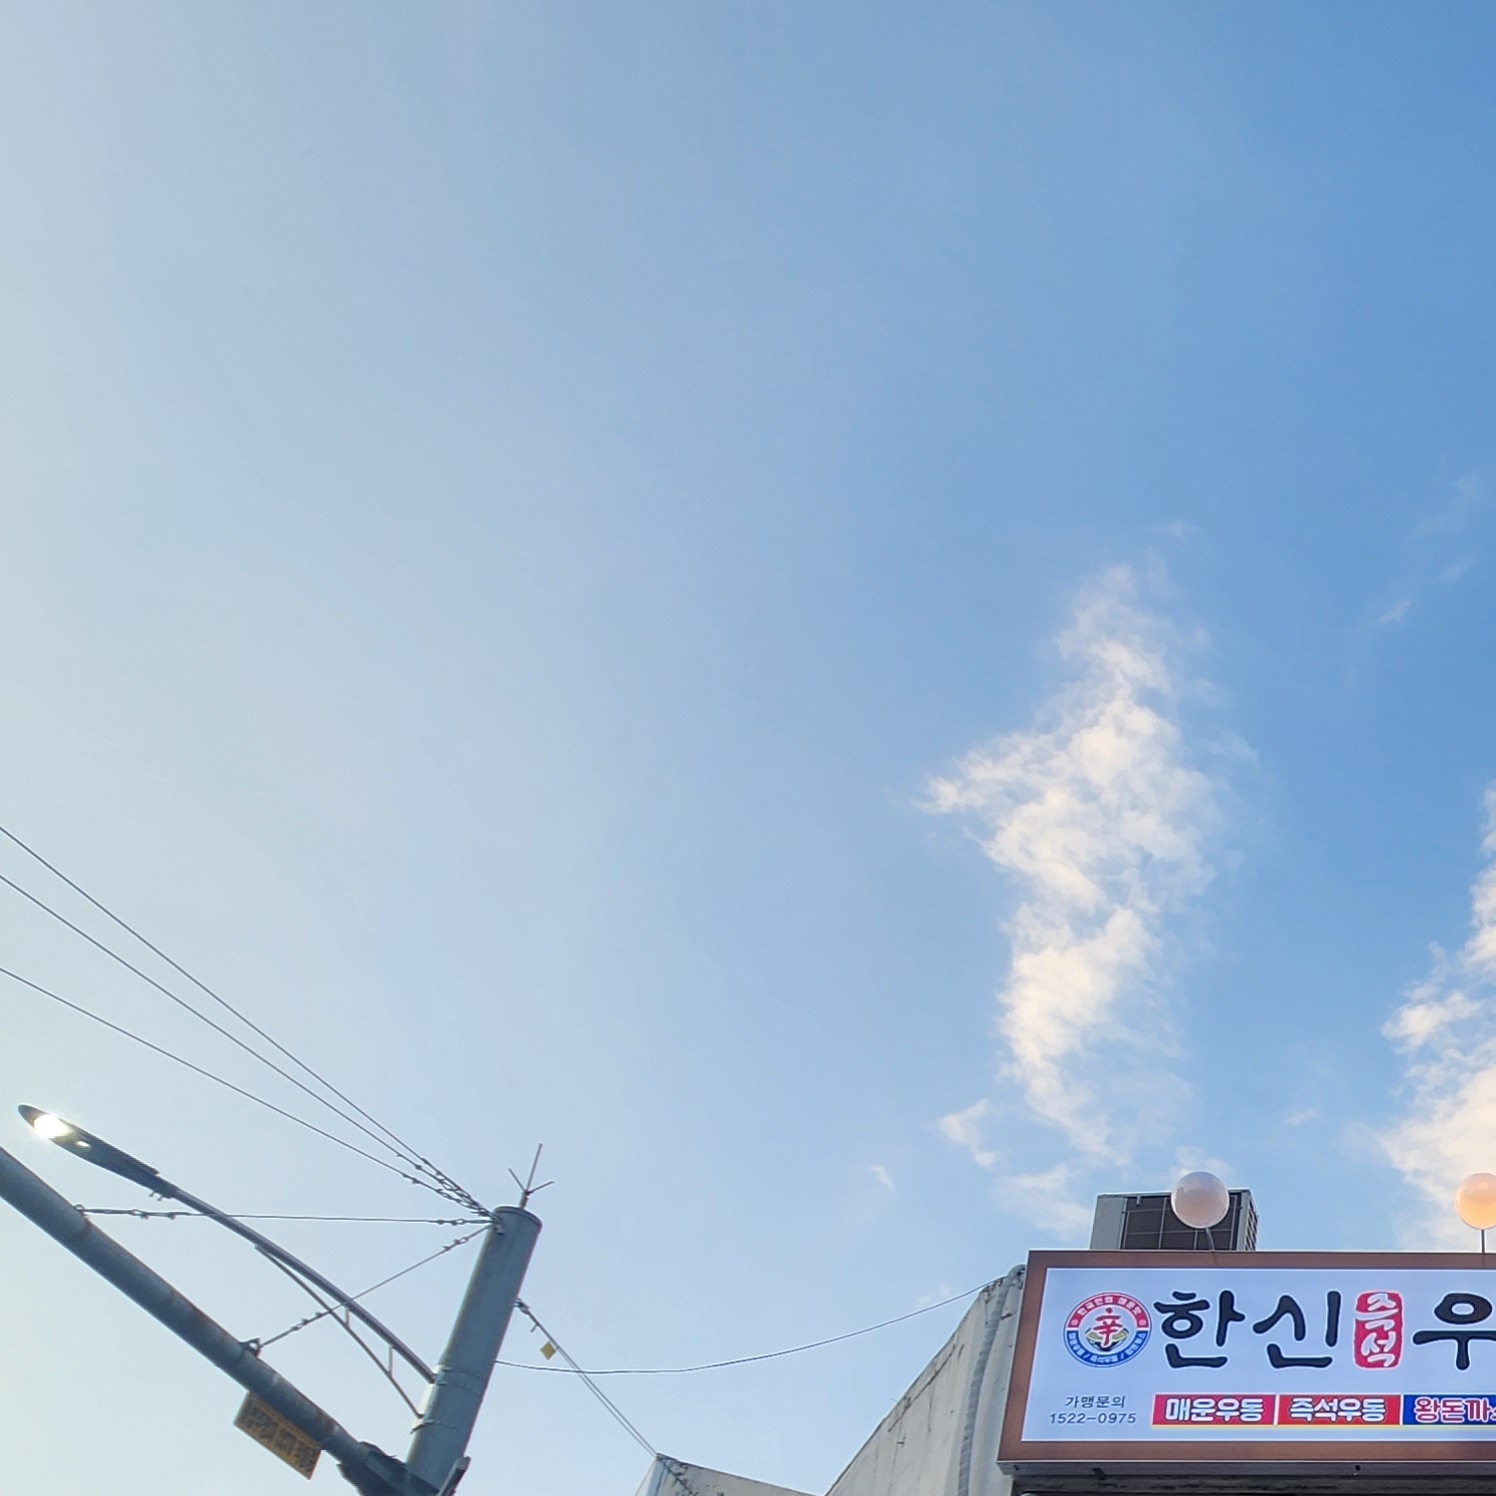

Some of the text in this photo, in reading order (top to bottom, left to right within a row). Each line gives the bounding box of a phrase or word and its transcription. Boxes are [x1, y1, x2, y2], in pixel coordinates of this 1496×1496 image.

[1154, 1289, 1341, 1369] 한신
[1356, 1291, 1402, 1368] 즉석
[1065, 1395, 1125, 1408] 가맹문의
[1165, 1397, 1264, 1422] 매운우동
[1289, 1397, 1387, 1422] 즉석우동
[1050, 1413, 1136, 1424] 1522-0975
